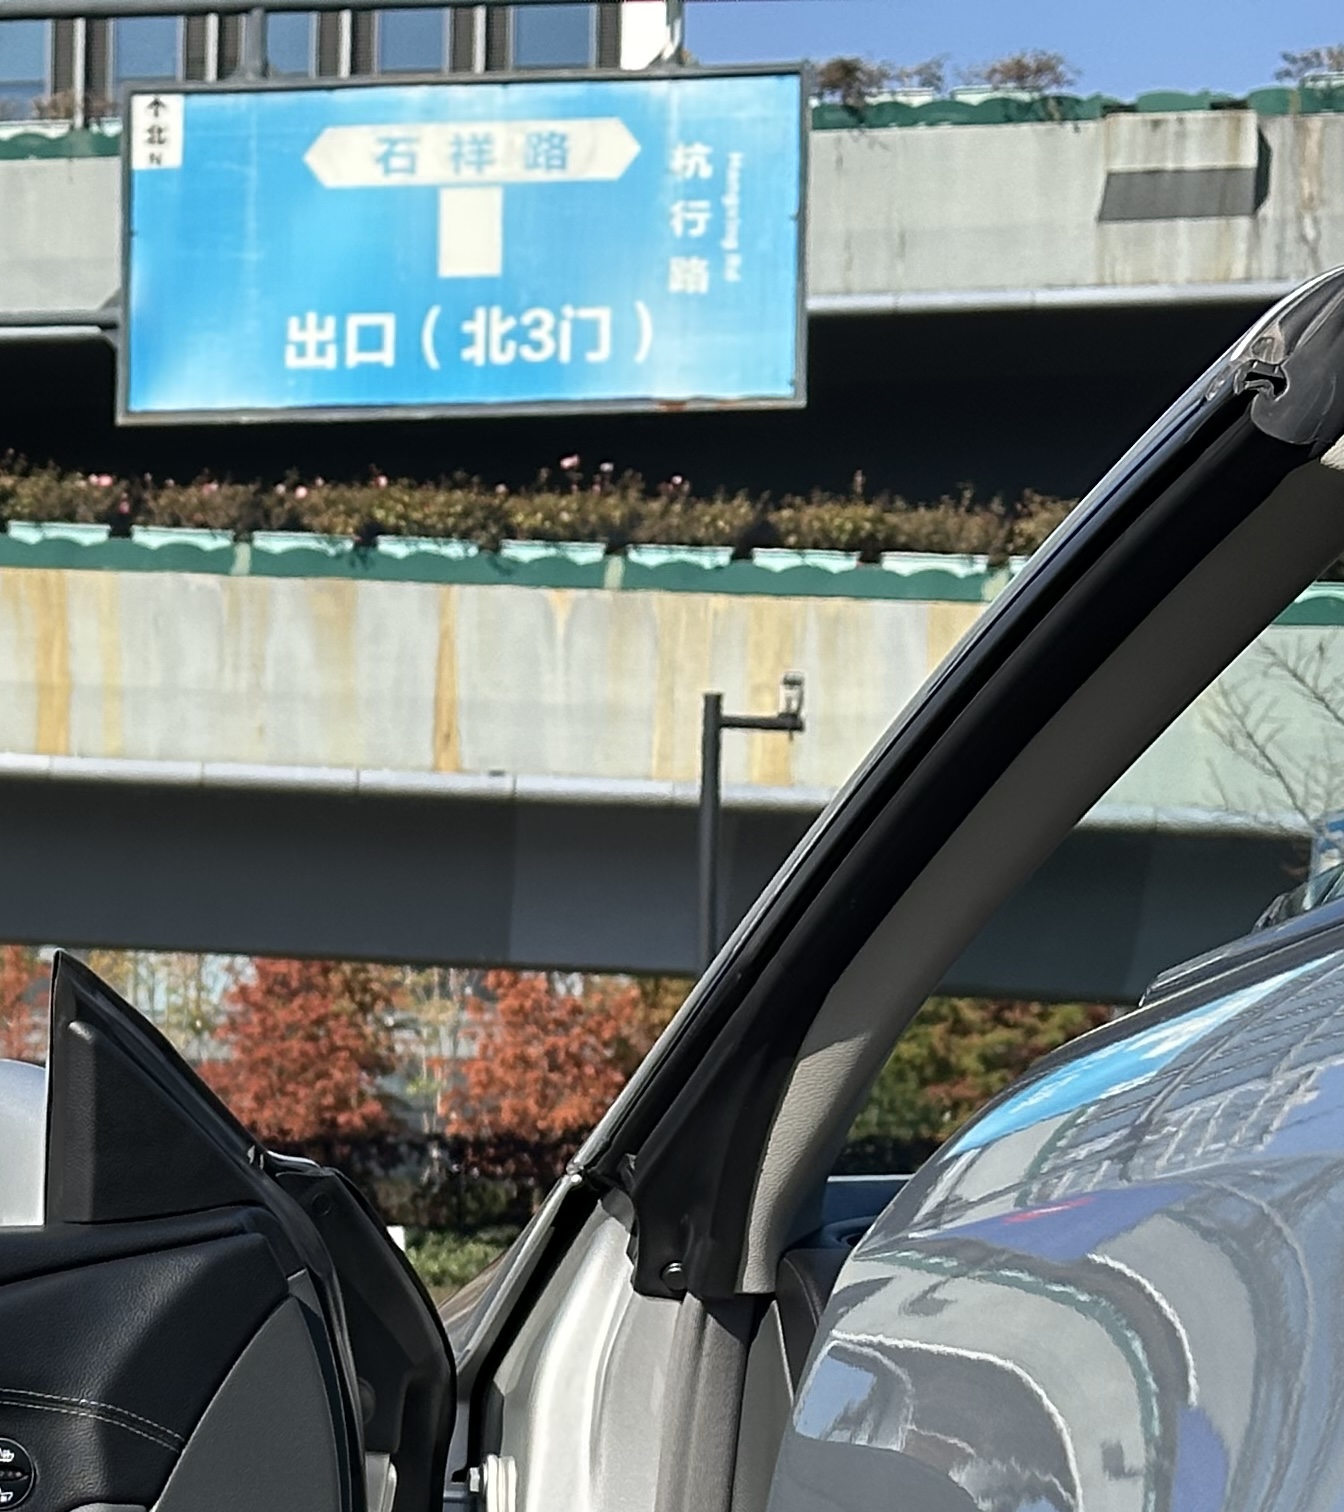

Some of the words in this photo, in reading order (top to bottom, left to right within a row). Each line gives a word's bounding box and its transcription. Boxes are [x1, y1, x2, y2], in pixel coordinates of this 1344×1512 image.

[146, 125, 166, 145] 北
[149, 153, 162, 166] N
[374, 130, 571, 177] 石祥路
